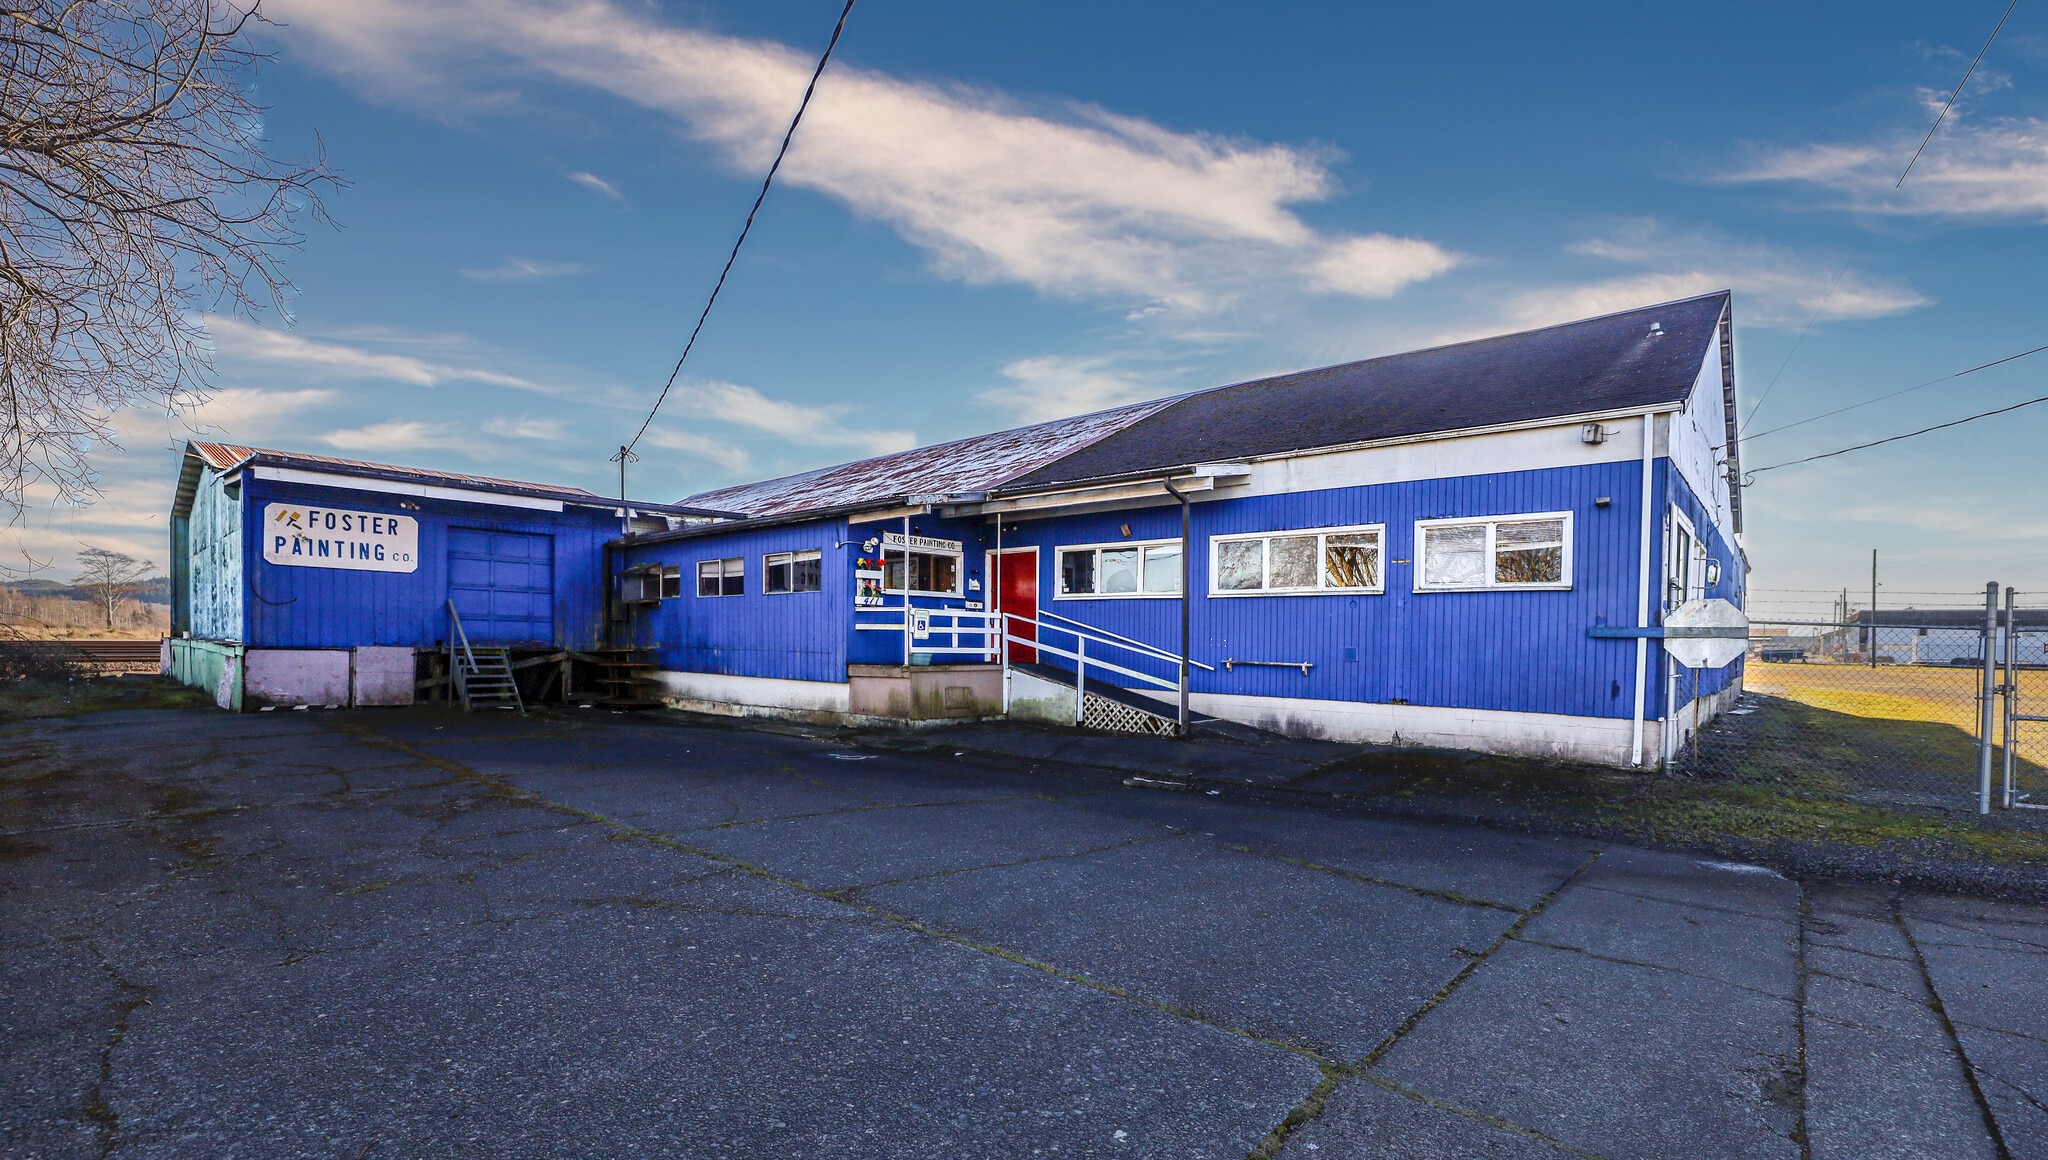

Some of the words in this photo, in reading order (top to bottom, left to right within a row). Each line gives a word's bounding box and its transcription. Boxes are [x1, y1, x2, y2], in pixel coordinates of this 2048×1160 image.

[309, 510, 398, 536] FOSTER
[275, 536, 385, 561] PAINTING
[893, 534, 918, 546] FOSER
[919, 538, 946, 549] PAINTING
